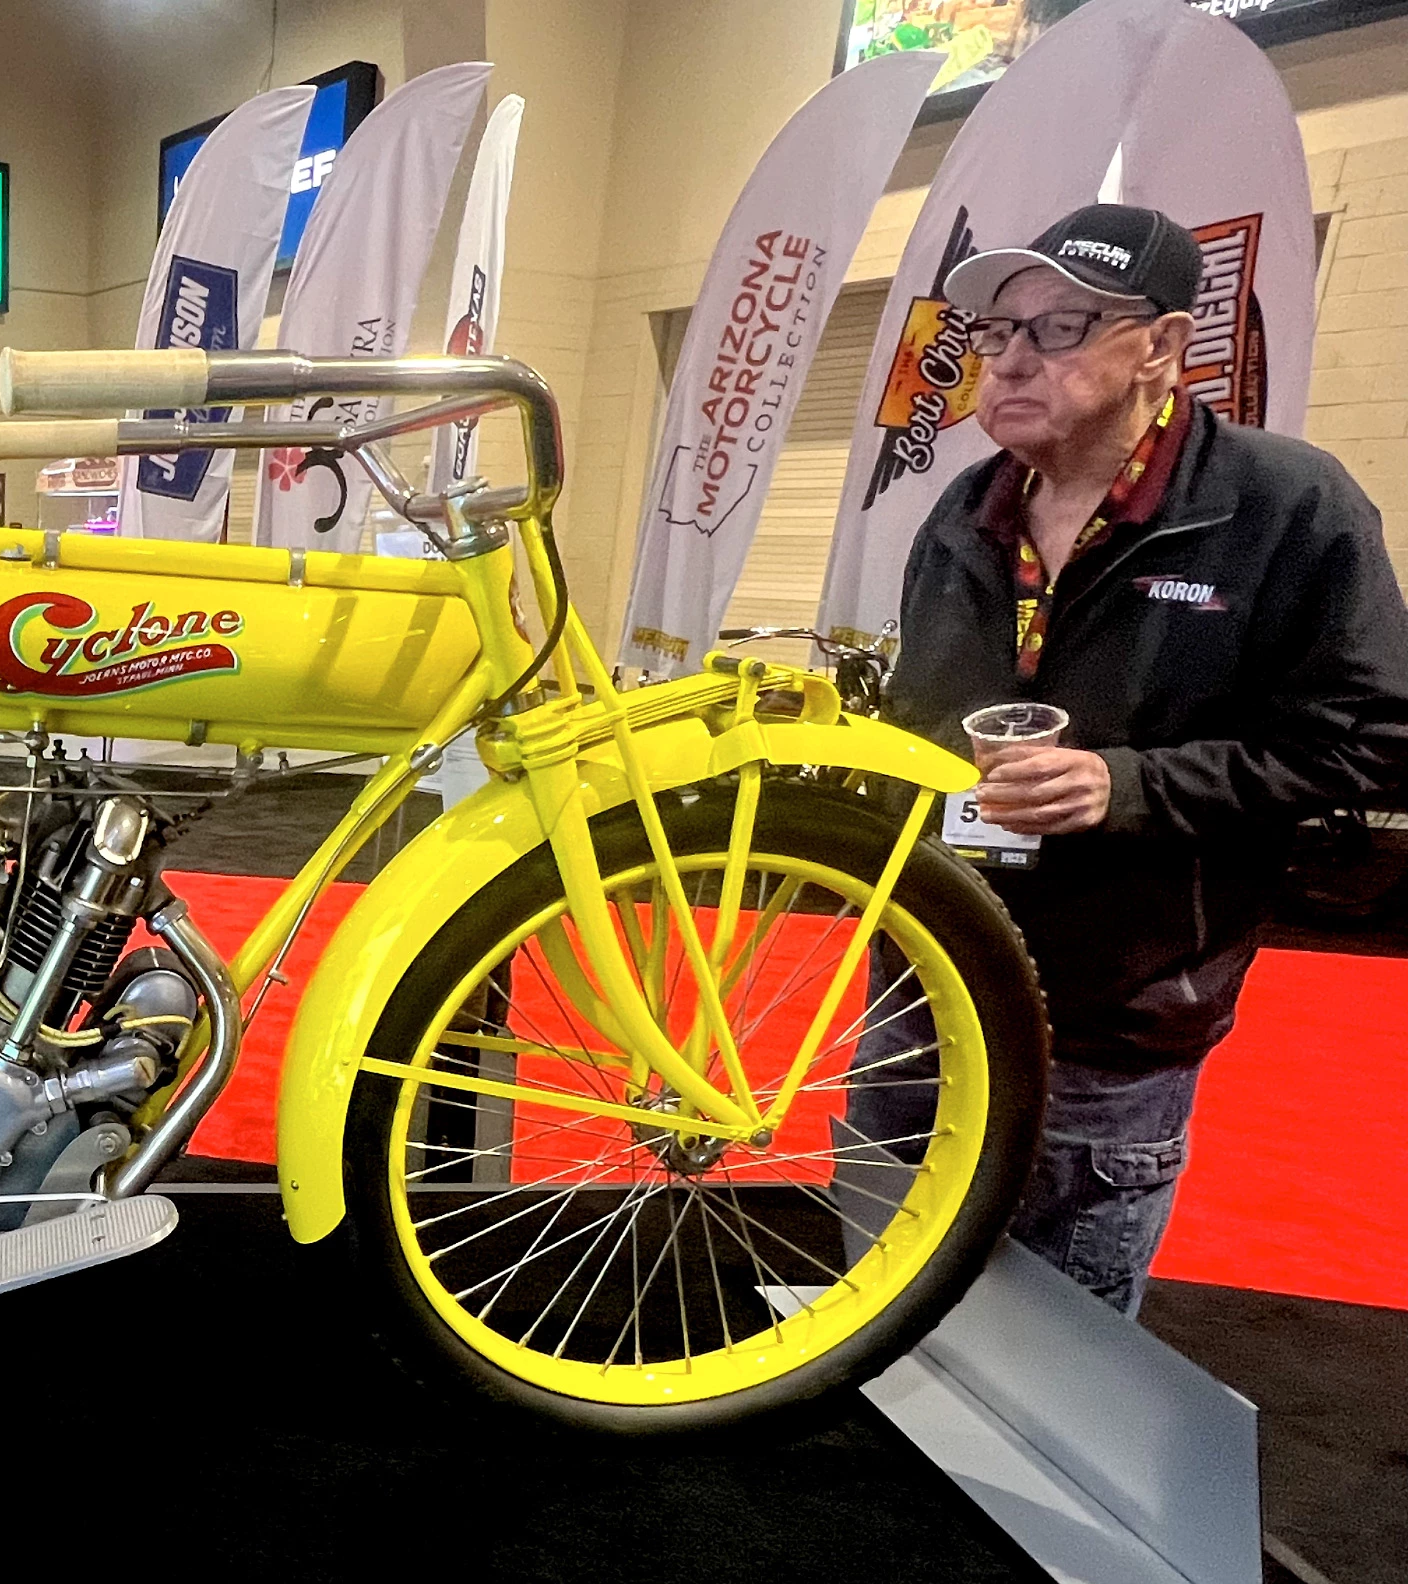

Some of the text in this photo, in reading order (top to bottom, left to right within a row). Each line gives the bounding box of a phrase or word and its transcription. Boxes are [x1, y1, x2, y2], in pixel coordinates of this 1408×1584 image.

[693, 229, 783, 473] THE ARIZONA
[696, 234, 811, 517] MOTORCYCLE
[746, 246, 828, 453] COLLECTION
[892, 308, 977, 472] Bert Chris
[128, 655, 168, 673] MOTOR
[1148, 580, 1215, 603] KORON
